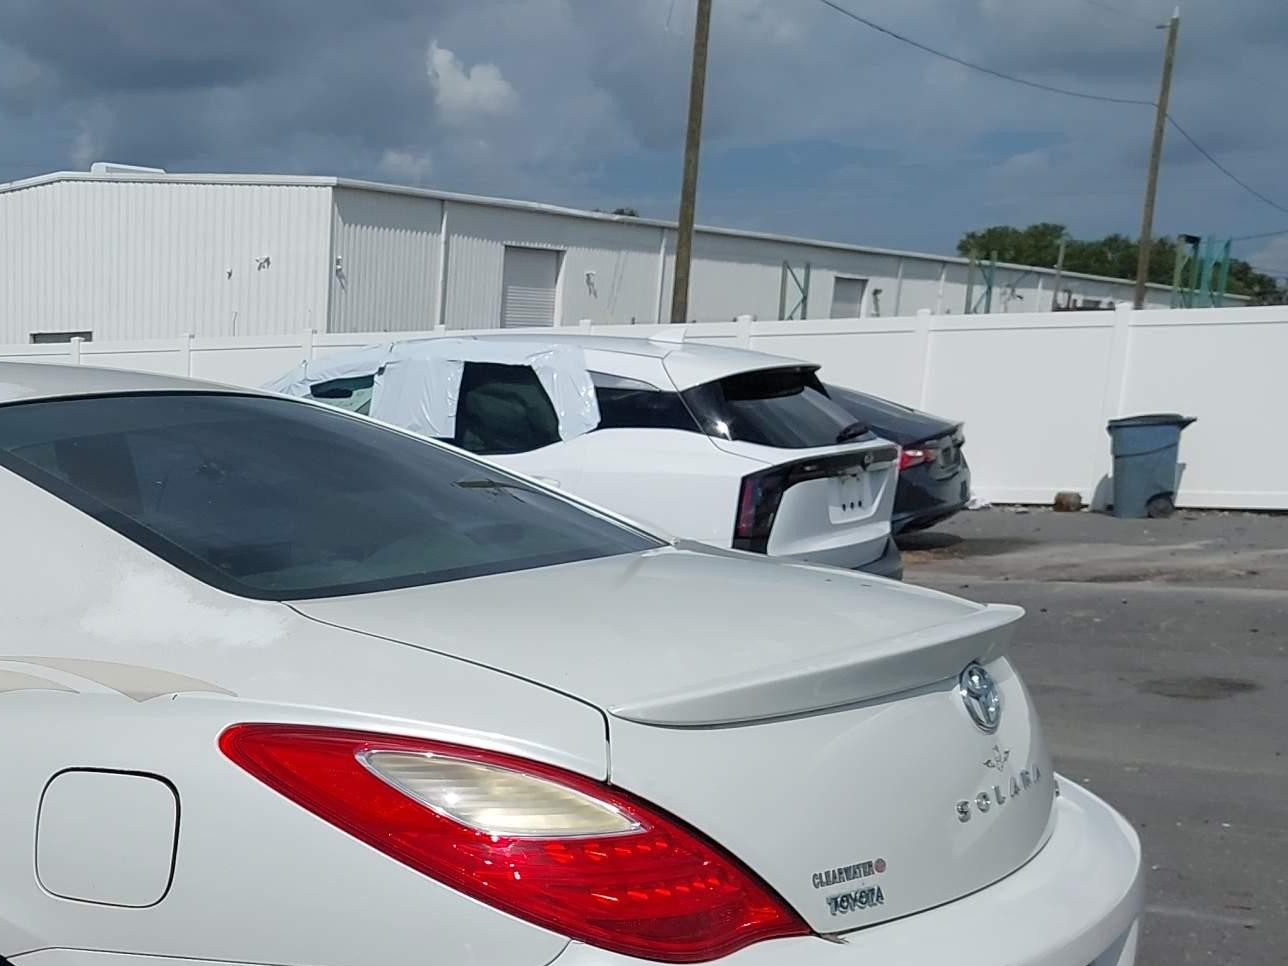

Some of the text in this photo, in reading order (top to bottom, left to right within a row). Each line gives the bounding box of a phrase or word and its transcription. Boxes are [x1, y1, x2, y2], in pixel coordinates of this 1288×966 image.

[956, 767, 1041, 823] SOLARA
[812, 860, 875, 889] CLEARWATER
[826, 886, 884, 916] TOYOTA
